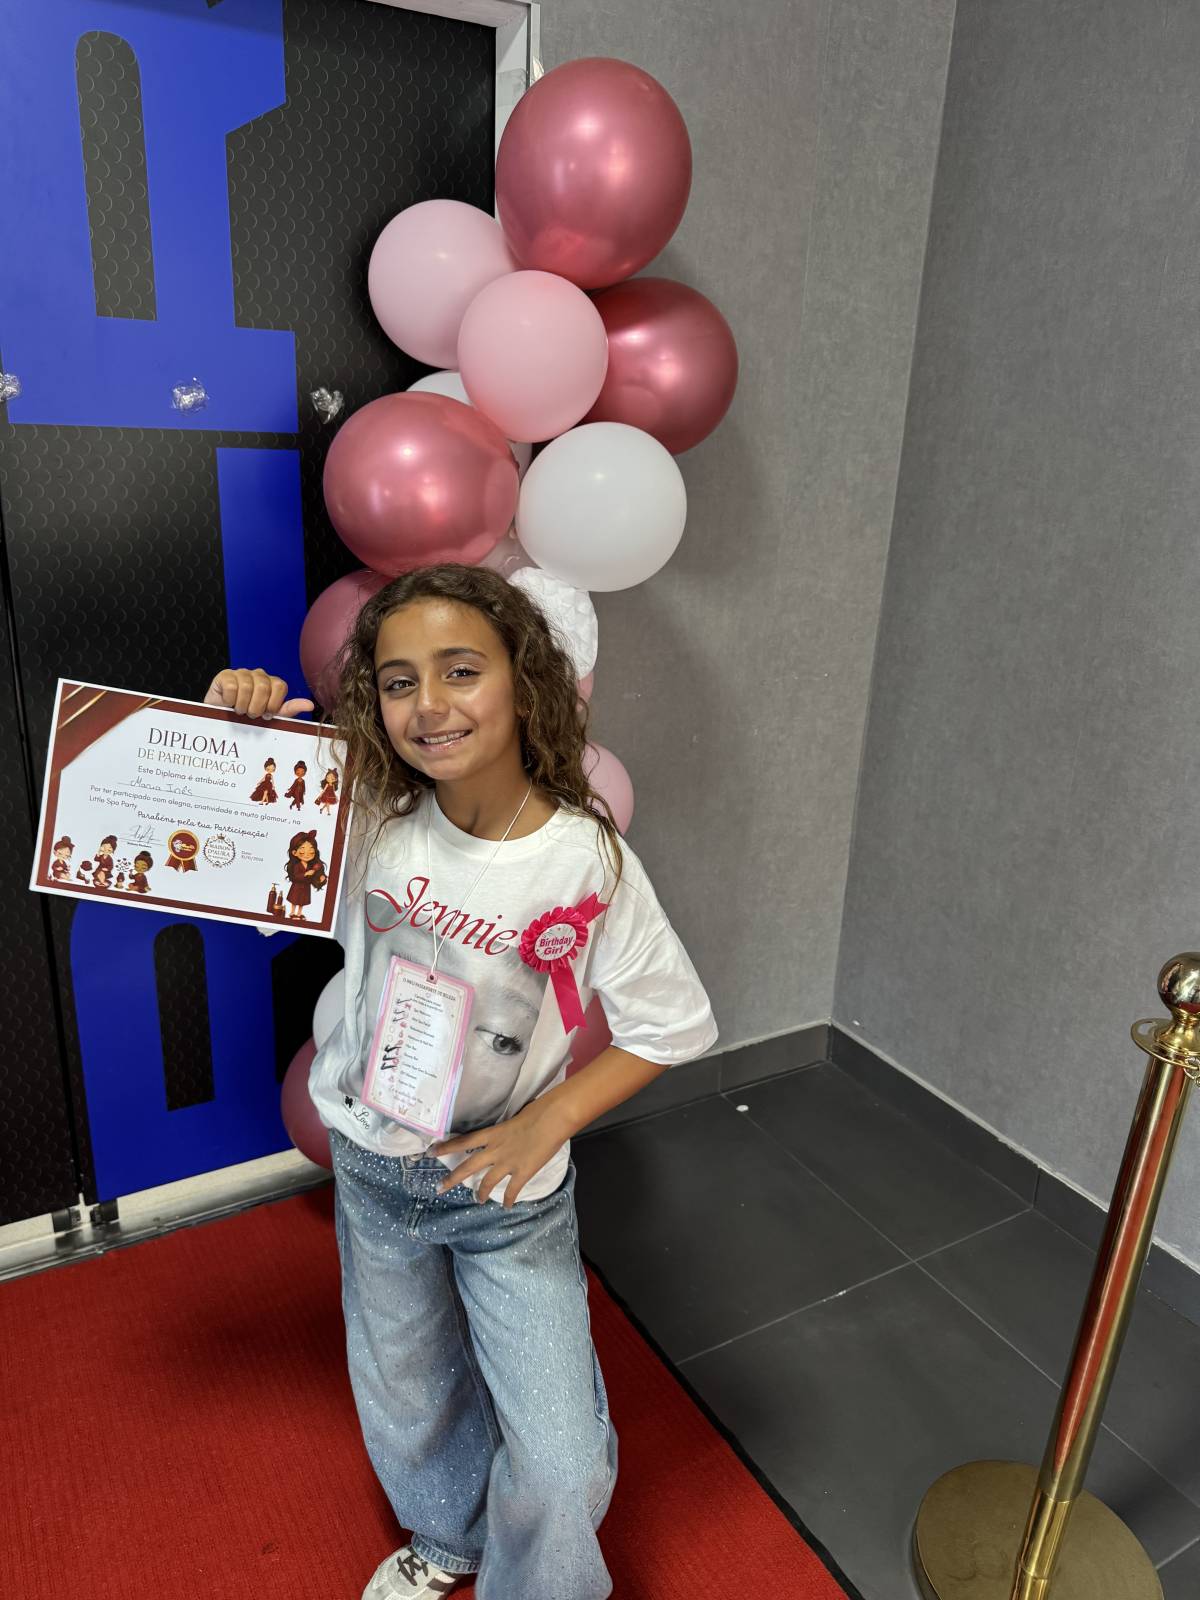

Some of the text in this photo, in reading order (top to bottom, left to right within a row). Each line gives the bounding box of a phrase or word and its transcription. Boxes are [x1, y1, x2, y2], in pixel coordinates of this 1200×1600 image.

[148, 727, 240, 758] DIPLOMA
[137, 747, 247, 775] DE PARTICIPAÇÃO
[138, 765, 154, 775] Este
[155, 768, 187, 780] Diploma
[195, 776, 229, 787] atribuído
[89, 795, 138, 810] Little Spa Party
[113, 789, 151, 801] participado
[194, 803, 233, 815] criatividade
[240, 811, 259, 819] muito
[260, 813, 288, 824] glamour
[138, 811, 269, 839] Parabéns pela tua Participação!
[365, 876, 518, 956] Jennie
[539, 935, 574, 948] Birthday
[543, 945, 564, 956] Girl
[354, 1107, 370, 1130] Love
